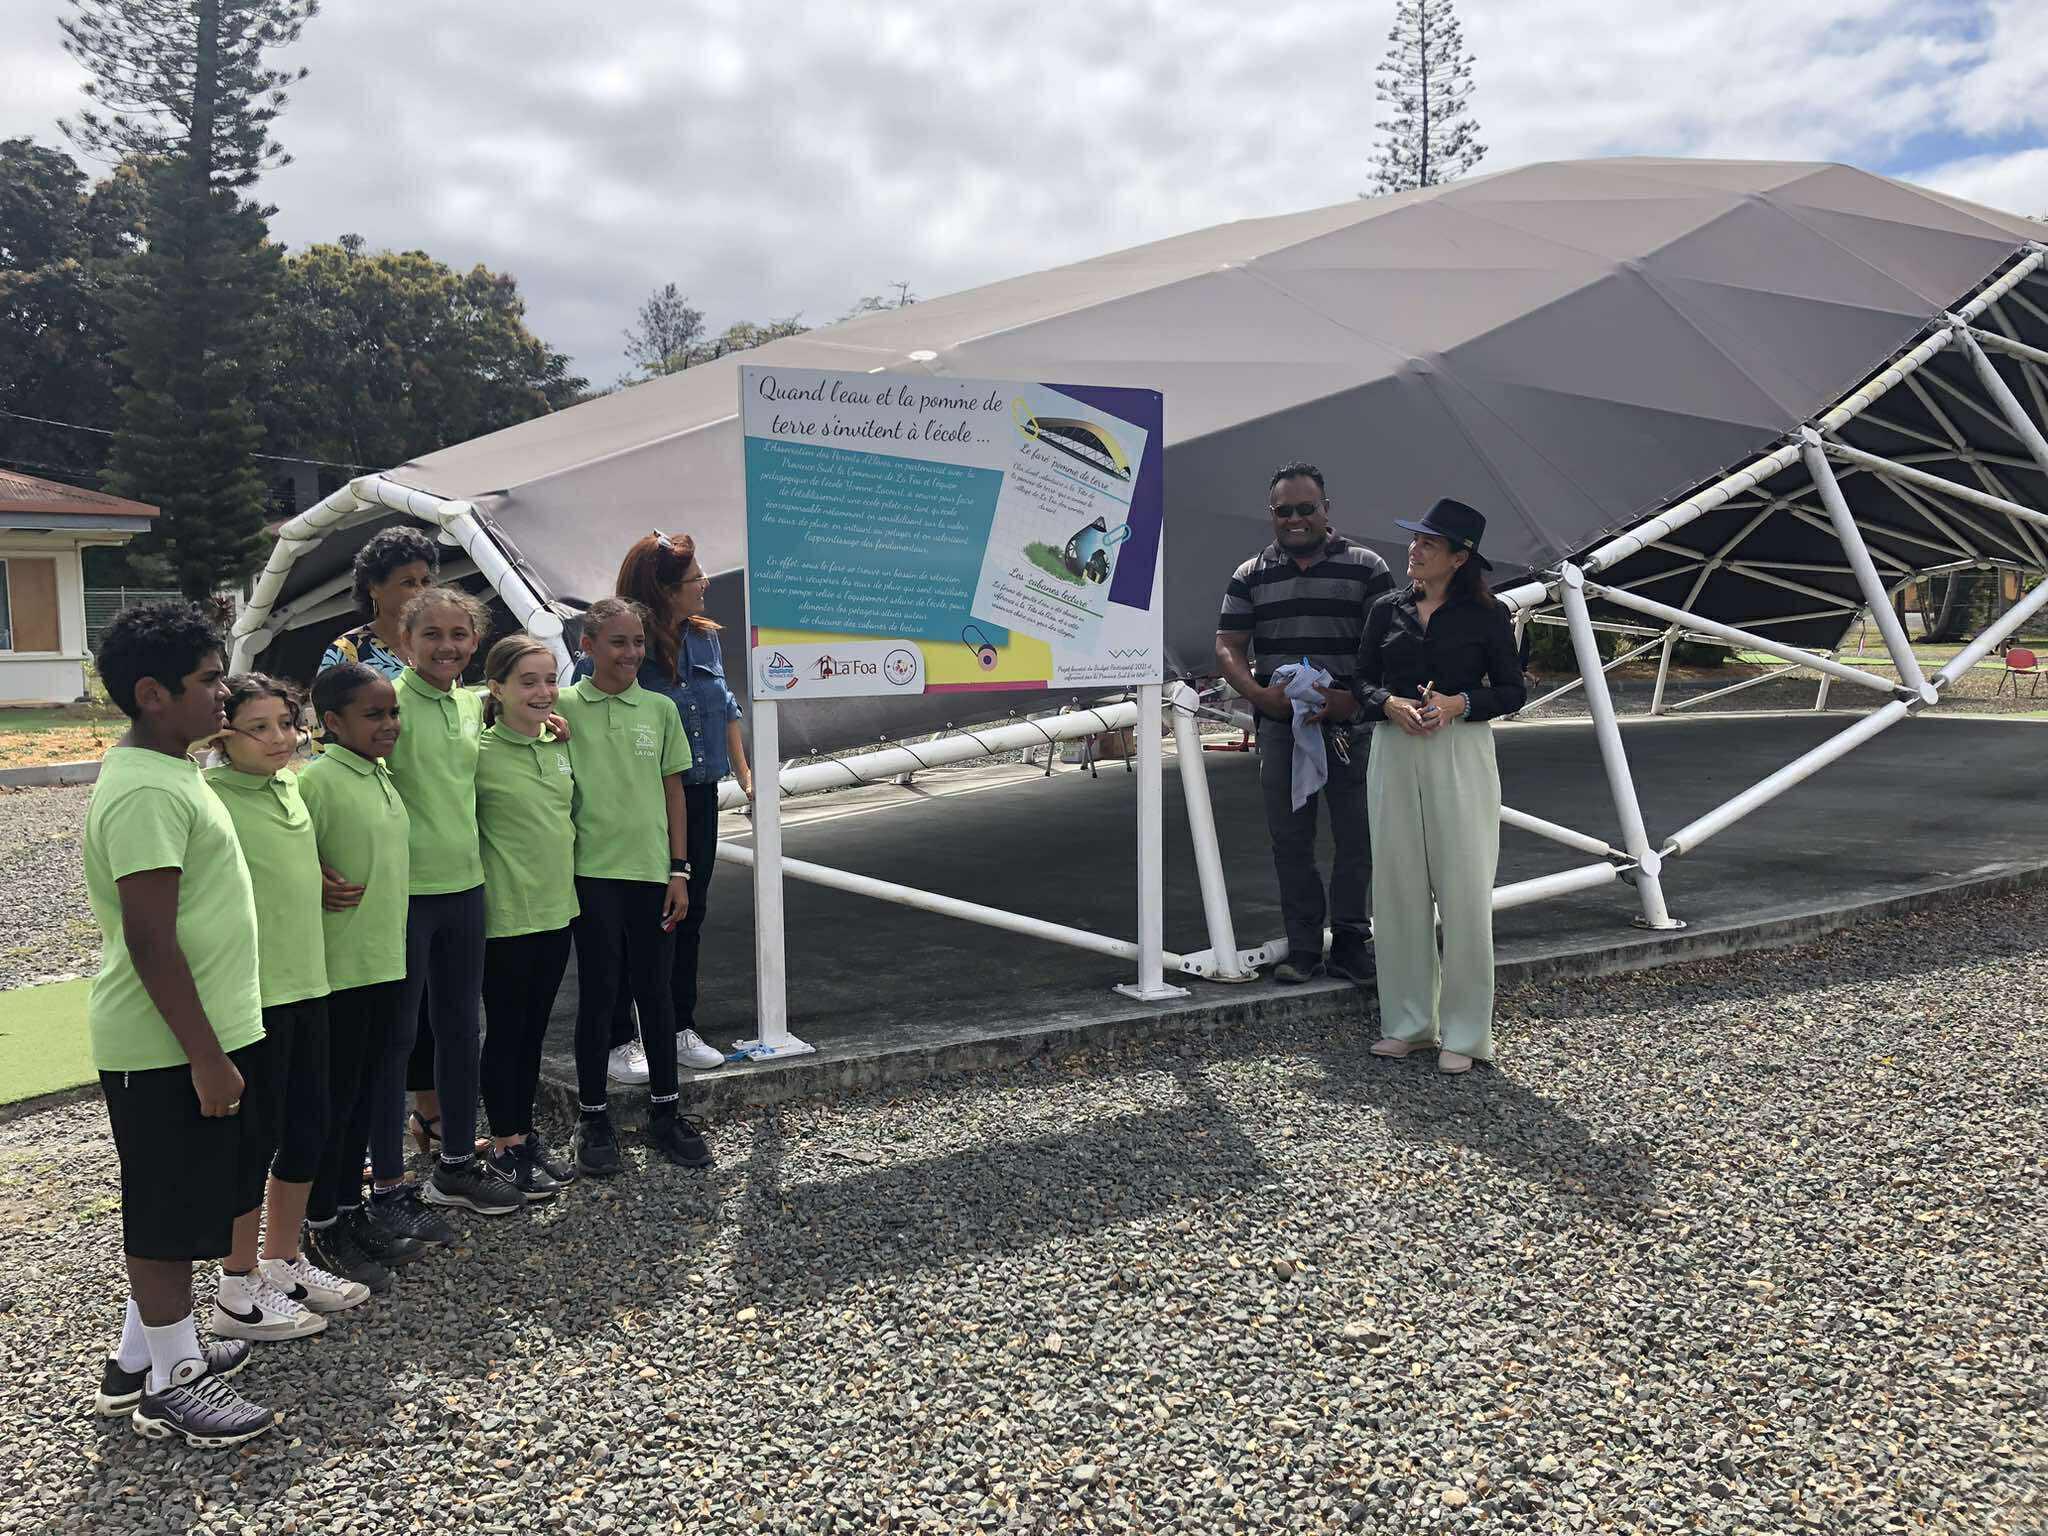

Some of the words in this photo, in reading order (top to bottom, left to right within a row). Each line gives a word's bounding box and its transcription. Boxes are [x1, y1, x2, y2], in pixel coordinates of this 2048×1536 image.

[759, 376, 826, 401] Quand
[831, 380, 870, 404] l'eau
[876, 385, 892, 406] et
[898, 385, 915, 407] la
[919, 394, 977, 413] pomme
[983, 390, 1002, 412] de
[772, 414, 816, 436] terre
[822, 414, 903, 439] s'invitent
[908, 422, 918, 440] à
[925, 419, 972, 443] l'école
[1080, 471, 1089, 481] de
[1009, 568, 1024, 581] Les
[834, 661, 850, 675] La
[854, 661, 877, 675] Foa
